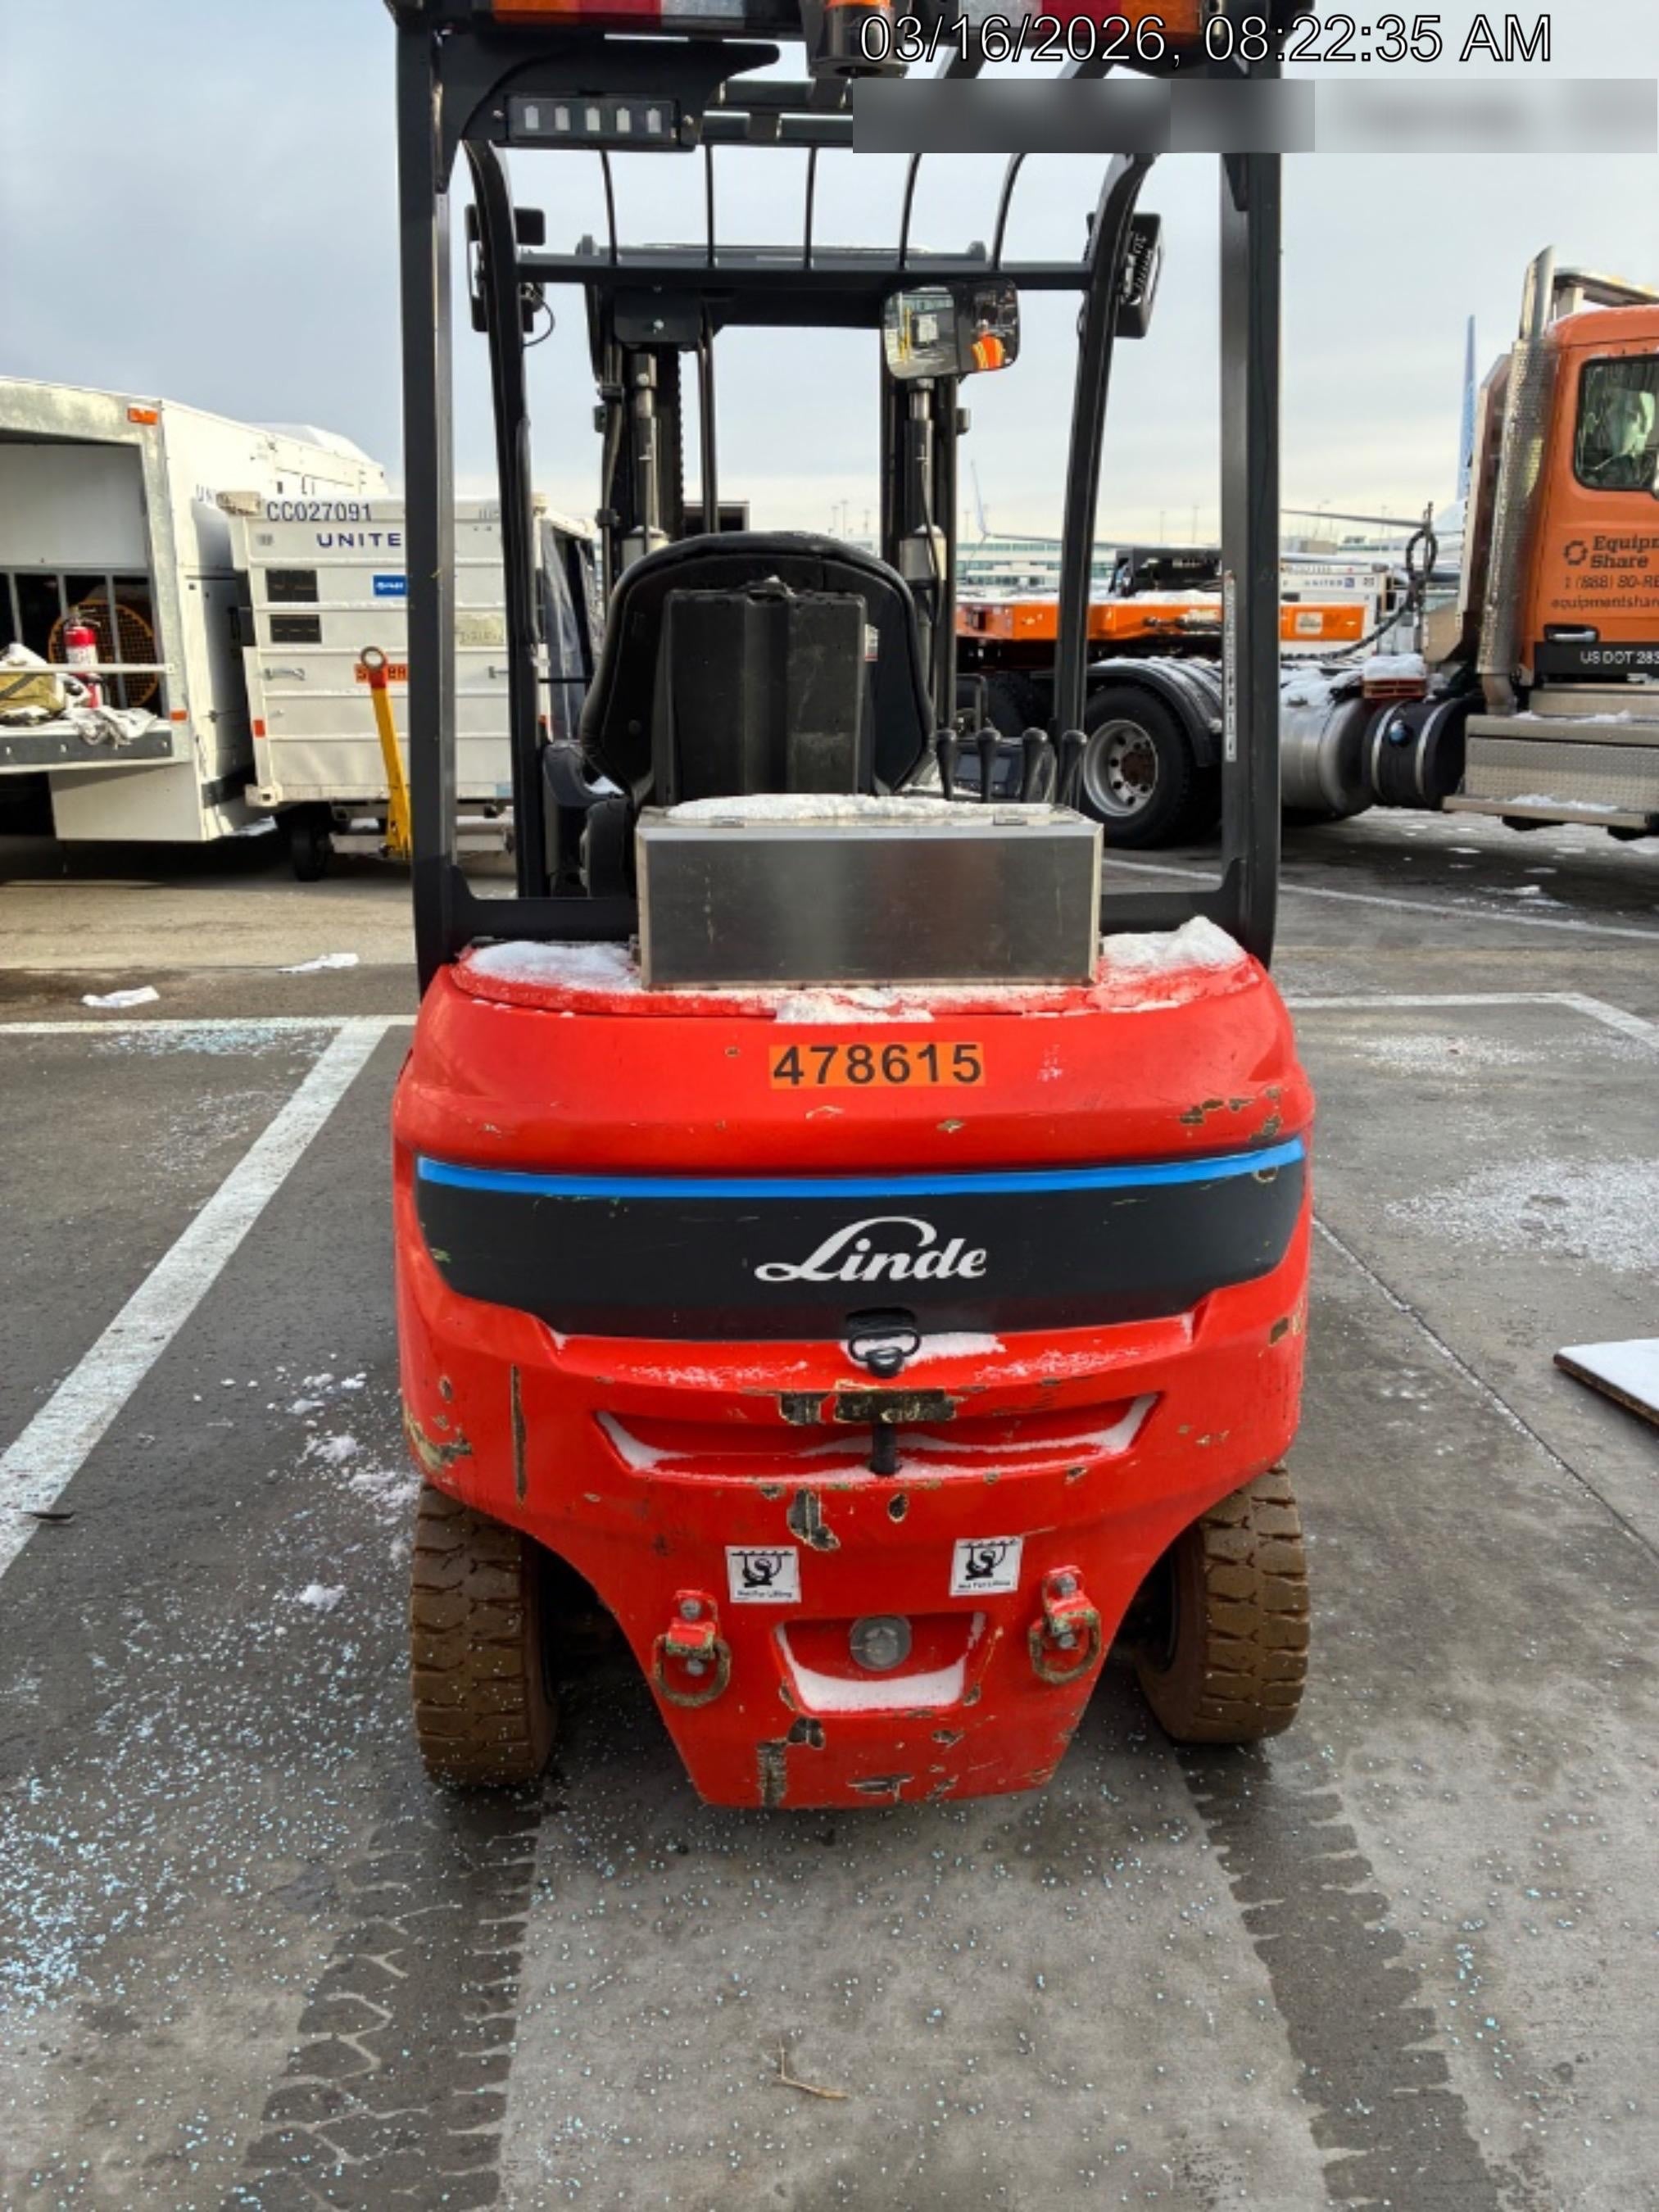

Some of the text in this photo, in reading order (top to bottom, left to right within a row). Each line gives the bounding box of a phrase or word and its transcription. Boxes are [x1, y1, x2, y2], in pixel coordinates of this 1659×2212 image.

[266, 501, 372, 522] CC027091
[316, 532, 401, 547] UNITE
[1590, 554, 1649, 569] Share
[1617, 575, 1659, 588] 80-RE
[1580, 650, 1601, 664] US
[1602, 650, 1634, 664] DOT
[773, 1043, 982, 1086] 478615
[754, 1216, 987, 1282] Linde
